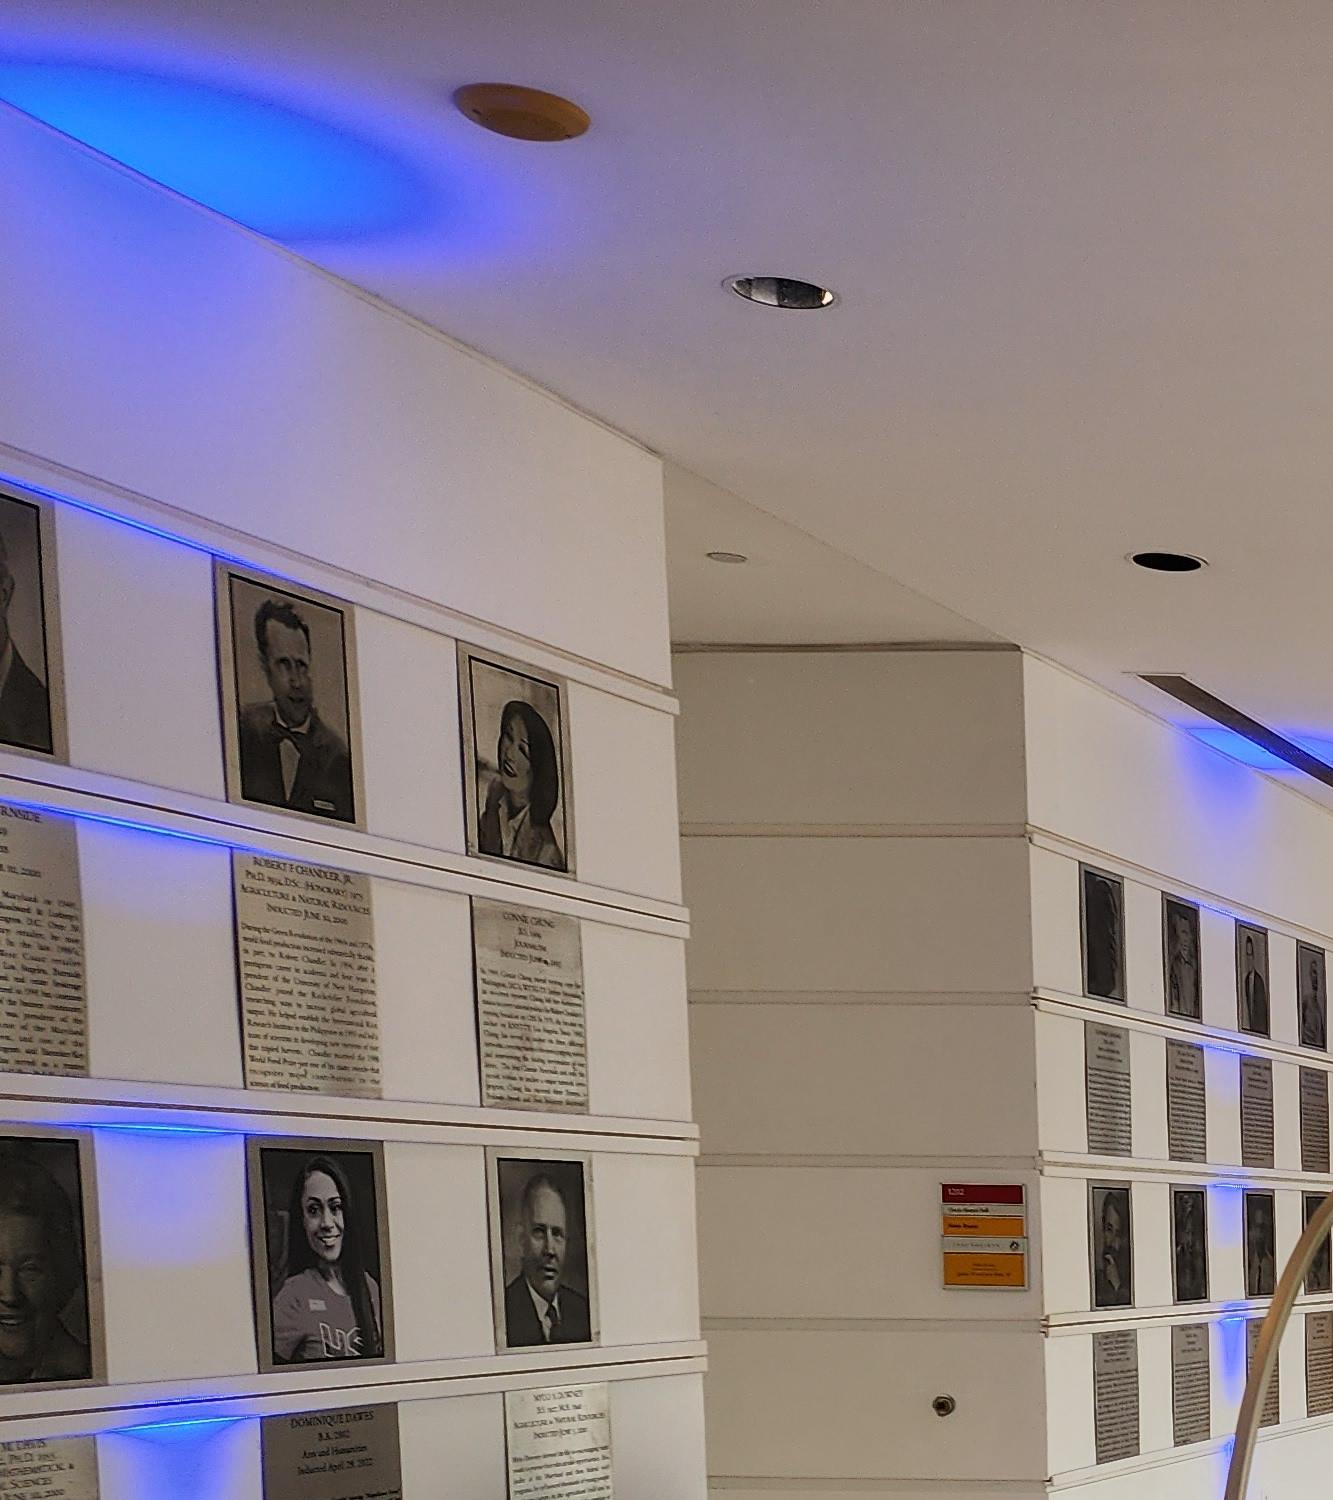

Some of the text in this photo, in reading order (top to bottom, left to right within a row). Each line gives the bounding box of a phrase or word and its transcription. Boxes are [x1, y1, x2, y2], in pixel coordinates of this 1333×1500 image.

[295, 865, 343, 883] CHANDLER
[291, 1410, 375, 1427] DOMINIQUE DAWES
